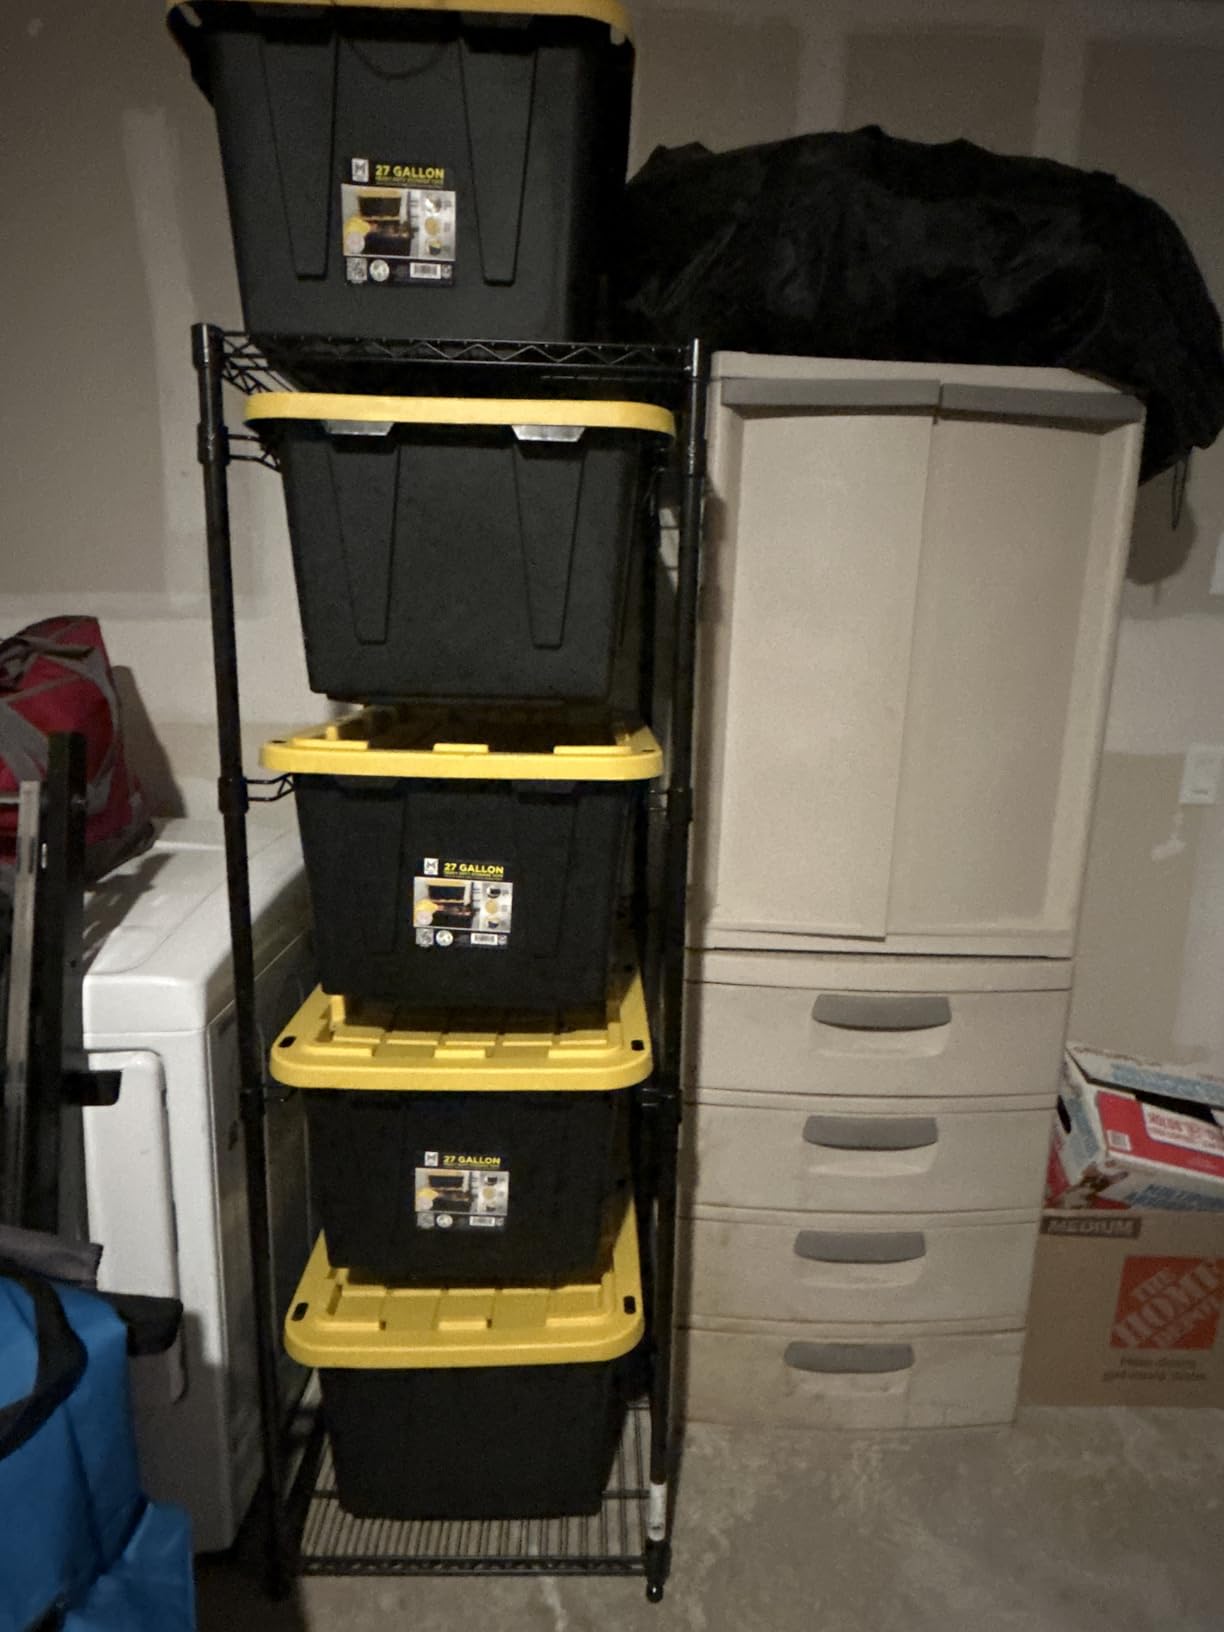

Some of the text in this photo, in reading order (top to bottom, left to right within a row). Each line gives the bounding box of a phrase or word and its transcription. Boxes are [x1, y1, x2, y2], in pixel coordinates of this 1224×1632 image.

[375, 164, 445, 178] 27 GALLON
[444, 862, 504, 874] 27 GALLON
[443, 1155, 501, 1164] 27 GALLON
[1048, 1219, 1134, 1234] MEDIUM
[1112, 1261, 1220, 1347] HOME
